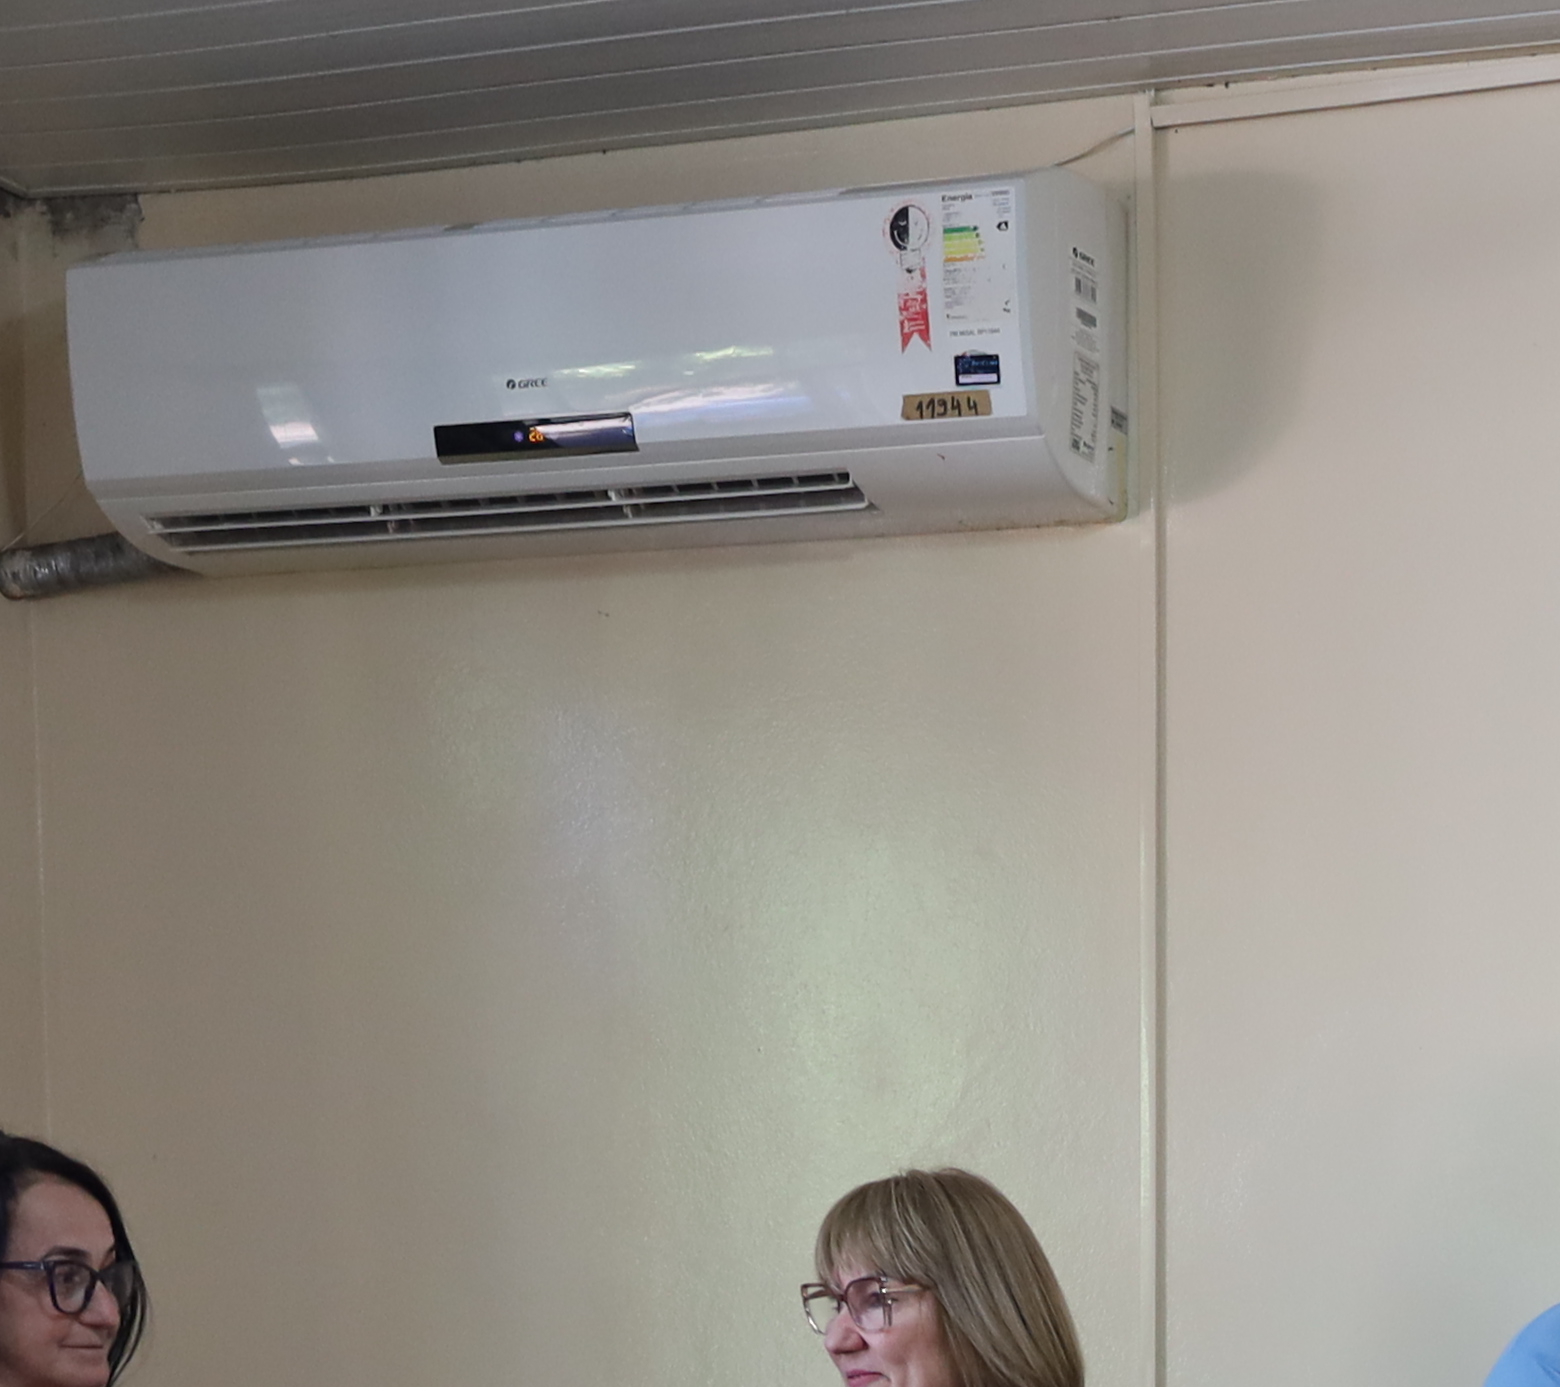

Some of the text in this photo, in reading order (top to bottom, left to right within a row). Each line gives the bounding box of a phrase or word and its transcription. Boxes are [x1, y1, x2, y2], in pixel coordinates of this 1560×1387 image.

[941, 193, 974, 203] Energia
[517, 378, 548, 389] GREE
[916, 395, 979, 419] 11944
